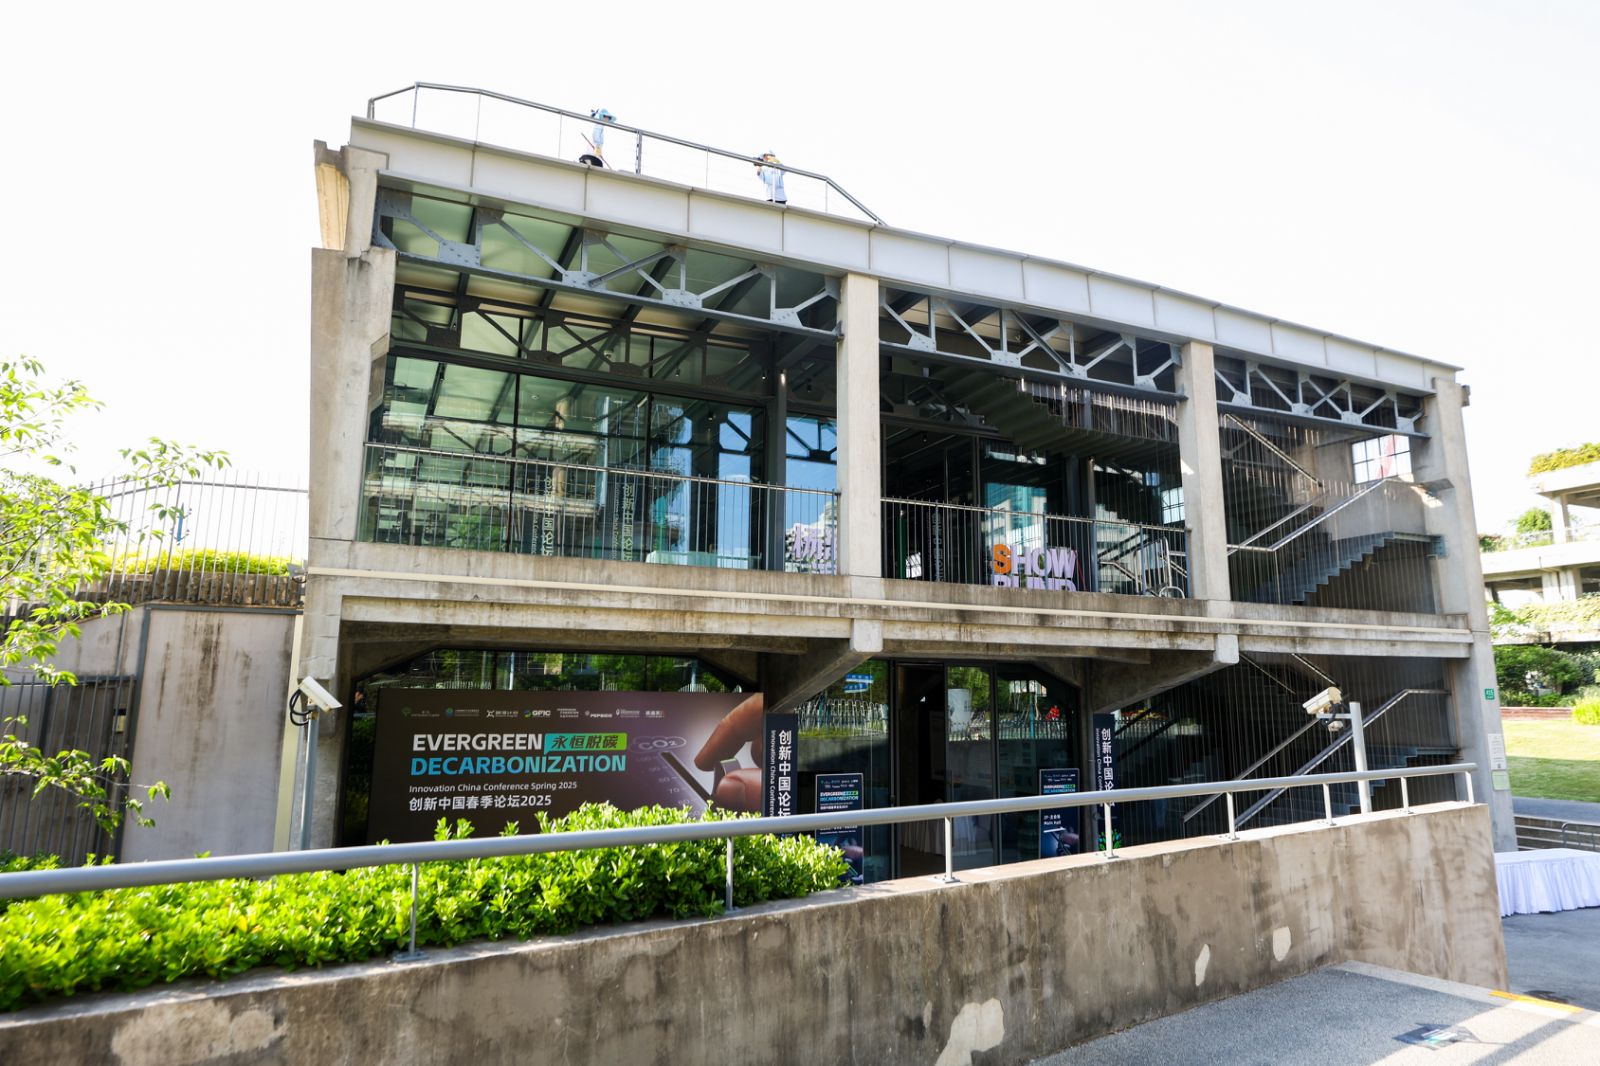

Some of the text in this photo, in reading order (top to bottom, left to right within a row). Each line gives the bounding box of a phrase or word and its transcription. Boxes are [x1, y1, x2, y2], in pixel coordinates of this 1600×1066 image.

[993, 544, 1077, 578] SHOW
[412, 733, 543, 751] EVERGREEN
[551, 735, 619, 749] 永恒脱碳
[410, 755, 627, 776] DECARBONIZATION
[409, 781, 578, 793] Innovation China Conference Spring 2025
[409, 794, 552, 812] 创新中国春季论坛2025
